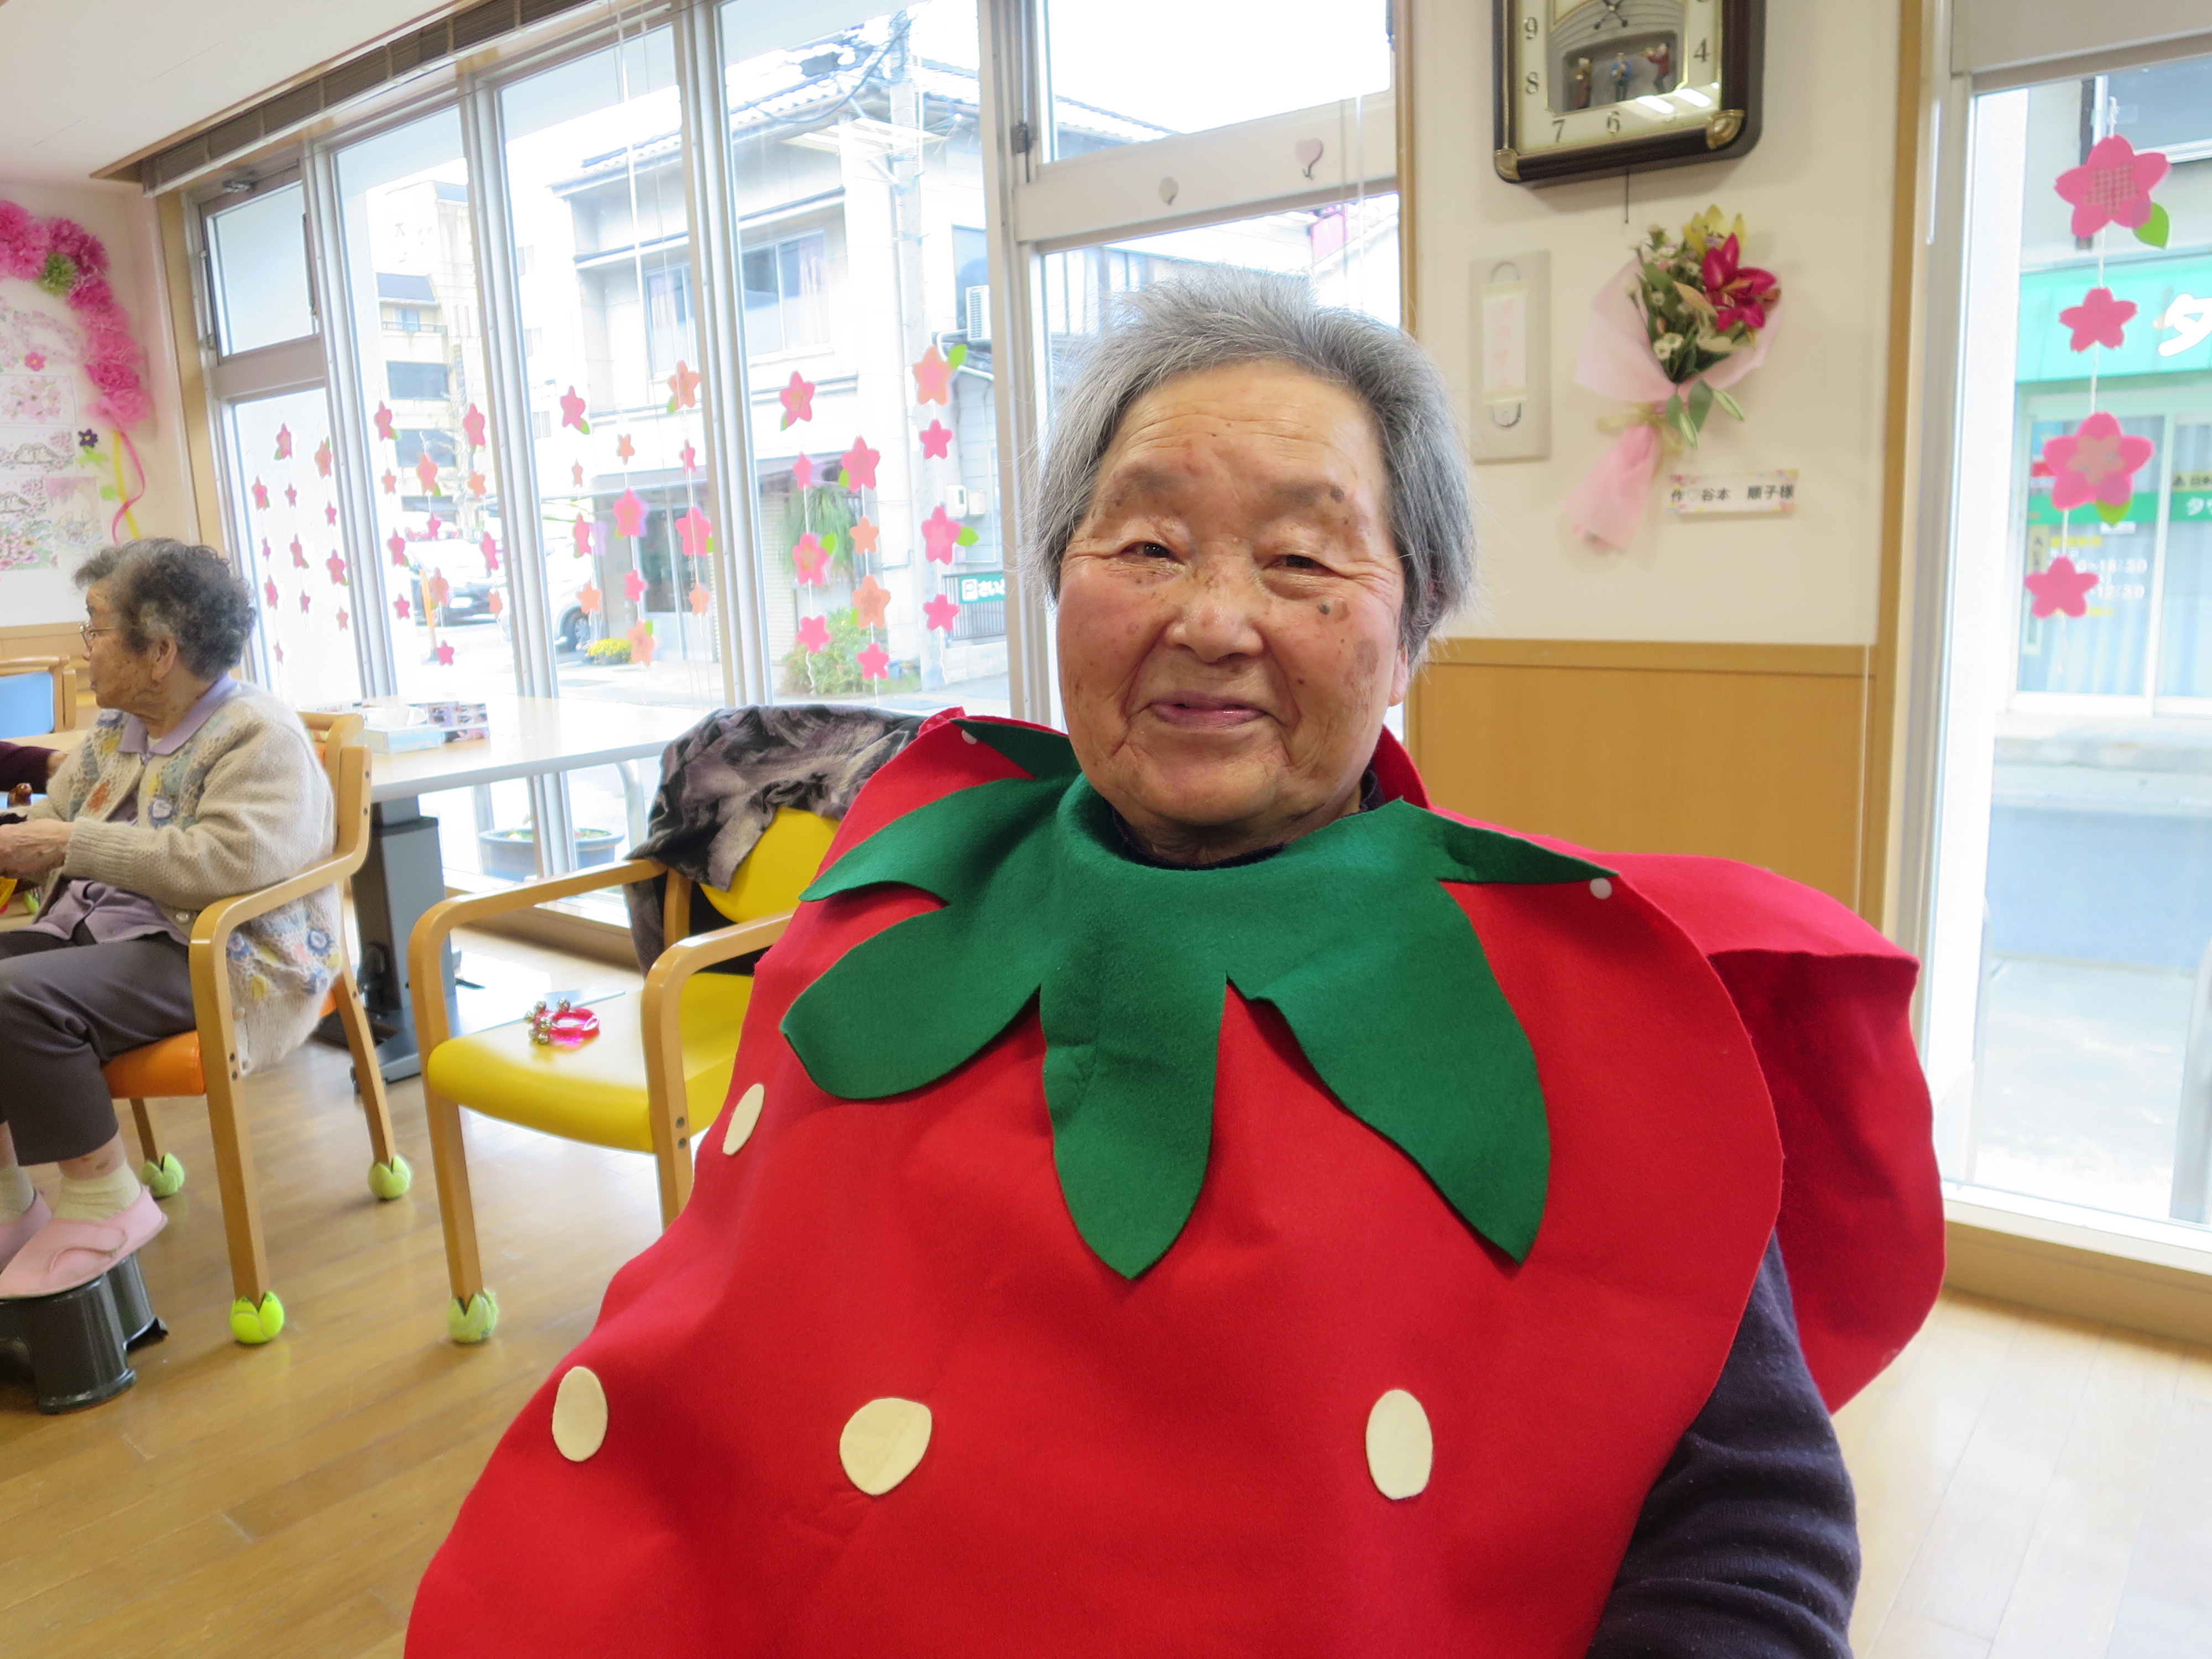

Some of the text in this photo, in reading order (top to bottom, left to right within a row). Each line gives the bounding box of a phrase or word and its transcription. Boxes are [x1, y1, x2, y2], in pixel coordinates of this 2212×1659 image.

[1523, 17, 1538, 39] 9
[1693, 38, 1710, 62] 4
[1525, 72, 1540, 94] 8
[1552, 117, 1566, 143] 7
[1606, 111, 1621, 134] 6
